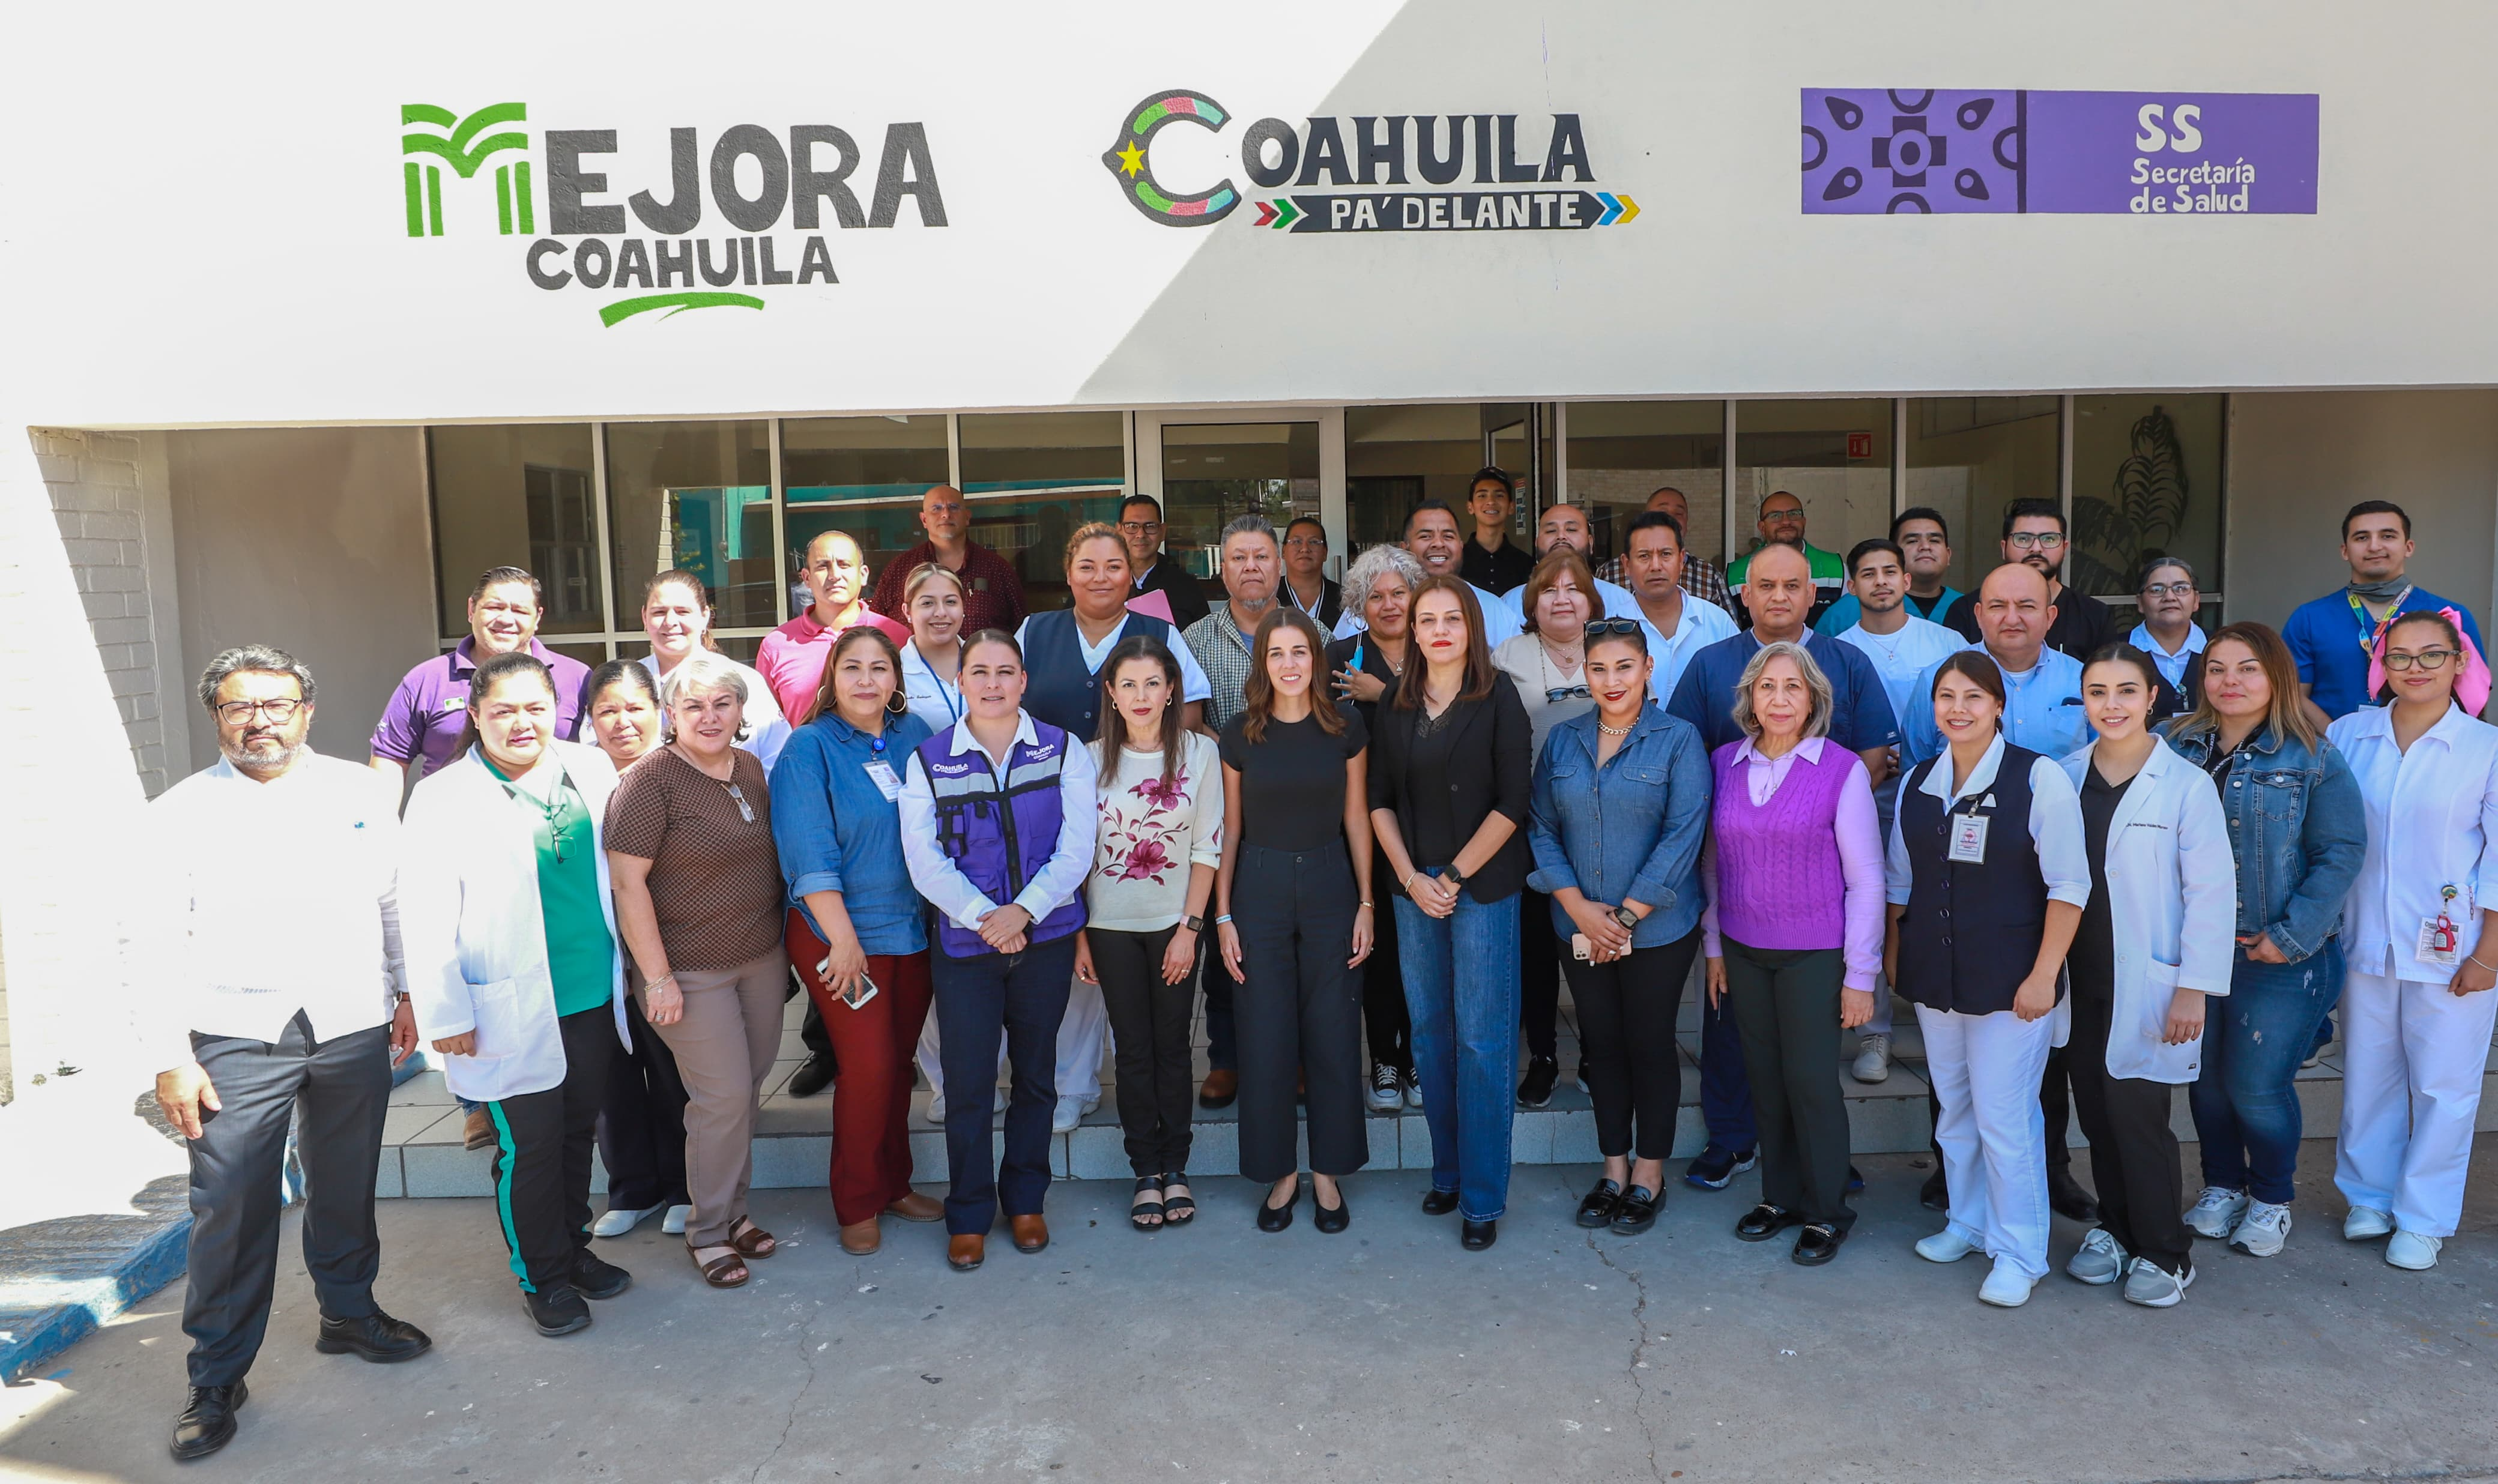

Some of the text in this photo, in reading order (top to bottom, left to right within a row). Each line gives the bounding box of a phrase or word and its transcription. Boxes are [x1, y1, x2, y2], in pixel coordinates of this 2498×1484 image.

[2136, 104, 2203, 152] SS
[401, 102, 949, 237] MEJORA
[1102, 89, 1595, 227] COAHUILA
[2130, 157, 2255, 185] Secretaría
[2130, 184, 2249, 214] de Salud
[526, 236, 841, 291] COAHUILA
[932, 763, 969, 772] COAHUILA
[1025, 744, 1055, 757] MEJORA
